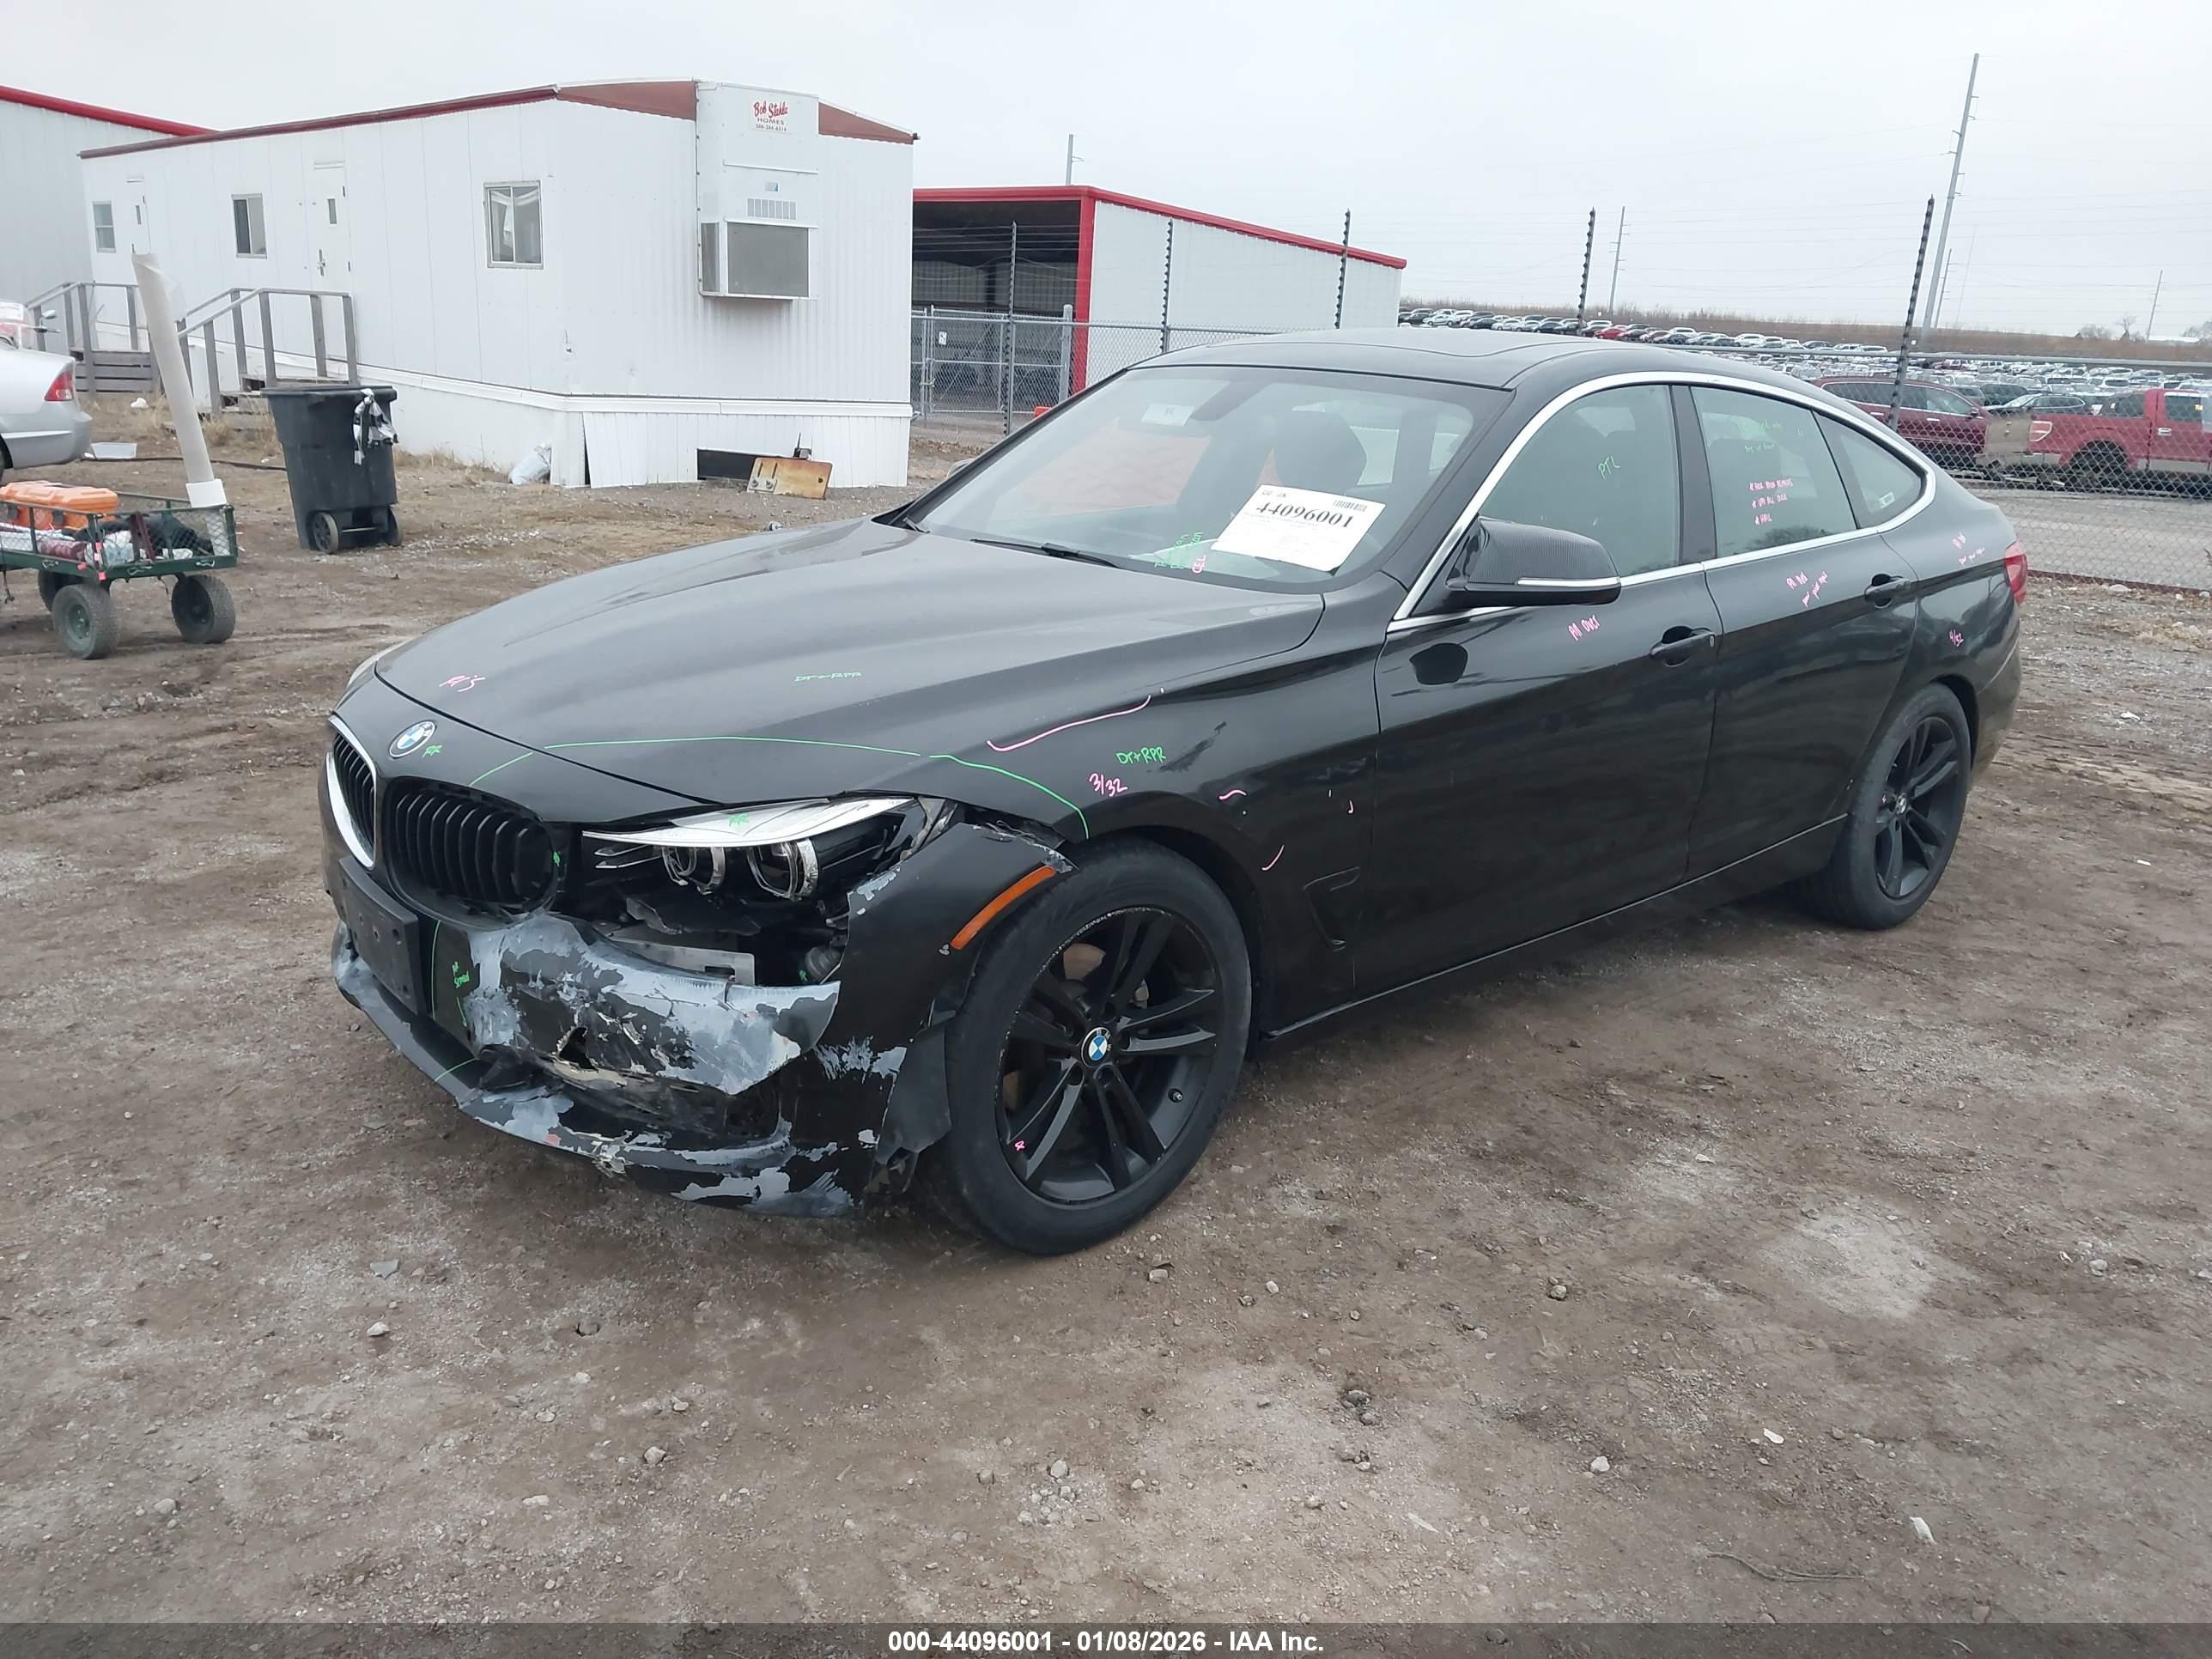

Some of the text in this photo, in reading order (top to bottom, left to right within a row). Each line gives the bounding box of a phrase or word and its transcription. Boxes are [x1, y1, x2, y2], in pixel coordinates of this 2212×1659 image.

[753, 100, 767, 117] Bob
[1255, 501, 1354, 529] 44096001
[1088, 772, 1128, 798] 3/32
